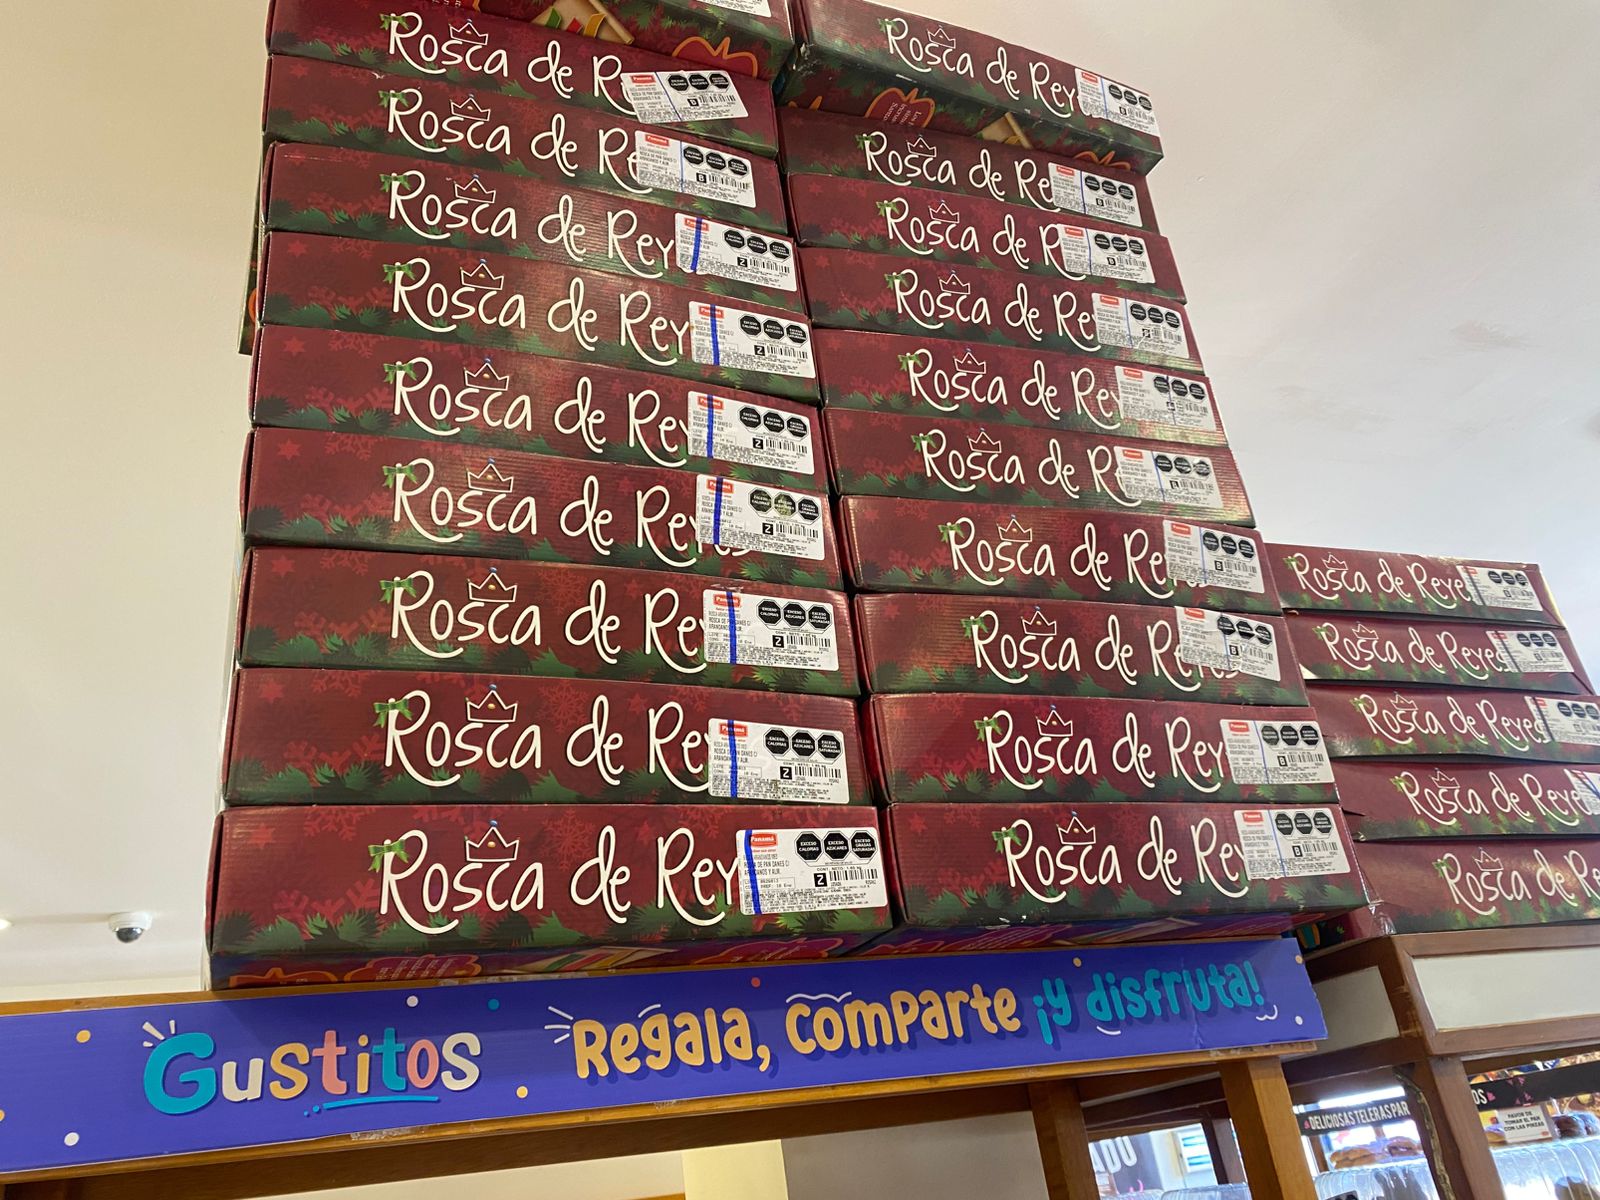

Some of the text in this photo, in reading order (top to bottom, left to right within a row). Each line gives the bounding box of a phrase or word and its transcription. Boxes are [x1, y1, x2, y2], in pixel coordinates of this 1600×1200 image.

[389, 12, 508, 77] Rosca
[528, 41, 574, 98] de
[885, 18, 975, 78] Rosca
[987, 47, 1020, 100] de
[1029, 62, 1076, 118] Rey
[388, 89, 511, 155] Rosca
[531, 114, 578, 177] de
[865, 132, 956, 186] Rosca
[969, 149, 1005, 201] de
[390, 170, 516, 239] Rosca
[538, 195, 586, 262] de
[607, 209, 675, 278] Rey
[885, 197, 979, 254] Rosca
[993, 214, 1029, 269] de
[394, 258, 689, 366] Rosca de Rey
[894, 269, 991, 329] Rosca
[1005, 283, 1043, 341] de
[394, 357, 531, 436] Rosca
[555, 377, 607, 453] de
[908, 349, 1008, 411] Rosca
[1022, 360, 1061, 420] de
[921, 429, 1025, 491] Rosca
[1038, 439, 1080, 498] de
[394, 458, 536, 542] Rosca
[560, 476, 614, 555] de
[949, 517, 1056, 585] Rosca
[1070, 523, 1112, 591] de
[1291, 553, 1372, 600] Rosca
[1377, 558, 1413, 603] de
[1406, 562, 1471, 609] Reye
[392, 571, 540, 658] Rosca
[566, 580, 621, 664] de
[774, 637, 782, 647] Z
[972, 610, 1080, 684] Rosca
[1095, 615, 1137, 685] de
[1320, 622, 1404, 670] Rosca
[1408, 627, 1445, 674] de
[385, 690, 541, 786] Rosca
[567, 695, 625, 785] de
[985, 710, 1224, 793] Rosca de Rey
[1355, 694, 1446, 744] Rosca
[1447, 696, 1488, 744] de
[782, 768, 790, 778] Z
[1396, 771, 1592, 826] Rosca de Reye
[381, 825, 738, 932] Rosca de Rey
[817, 874, 825, 885] Z
[1002, 819, 1122, 903] Rosca
[1137, 816, 1182, 895] de
[1438, 853, 1532, 915] Rosca
[1534, 849, 1579, 907] de
[143, 1027, 481, 1115] Gustitos
[572, 1007, 770, 1079] Regala,
[1087, 960, 1265, 1021] disfruta!
[1308, 1111, 1354, 1130] DELICIOSAS
[1354, 1105, 1393, 1124] TELERAS
